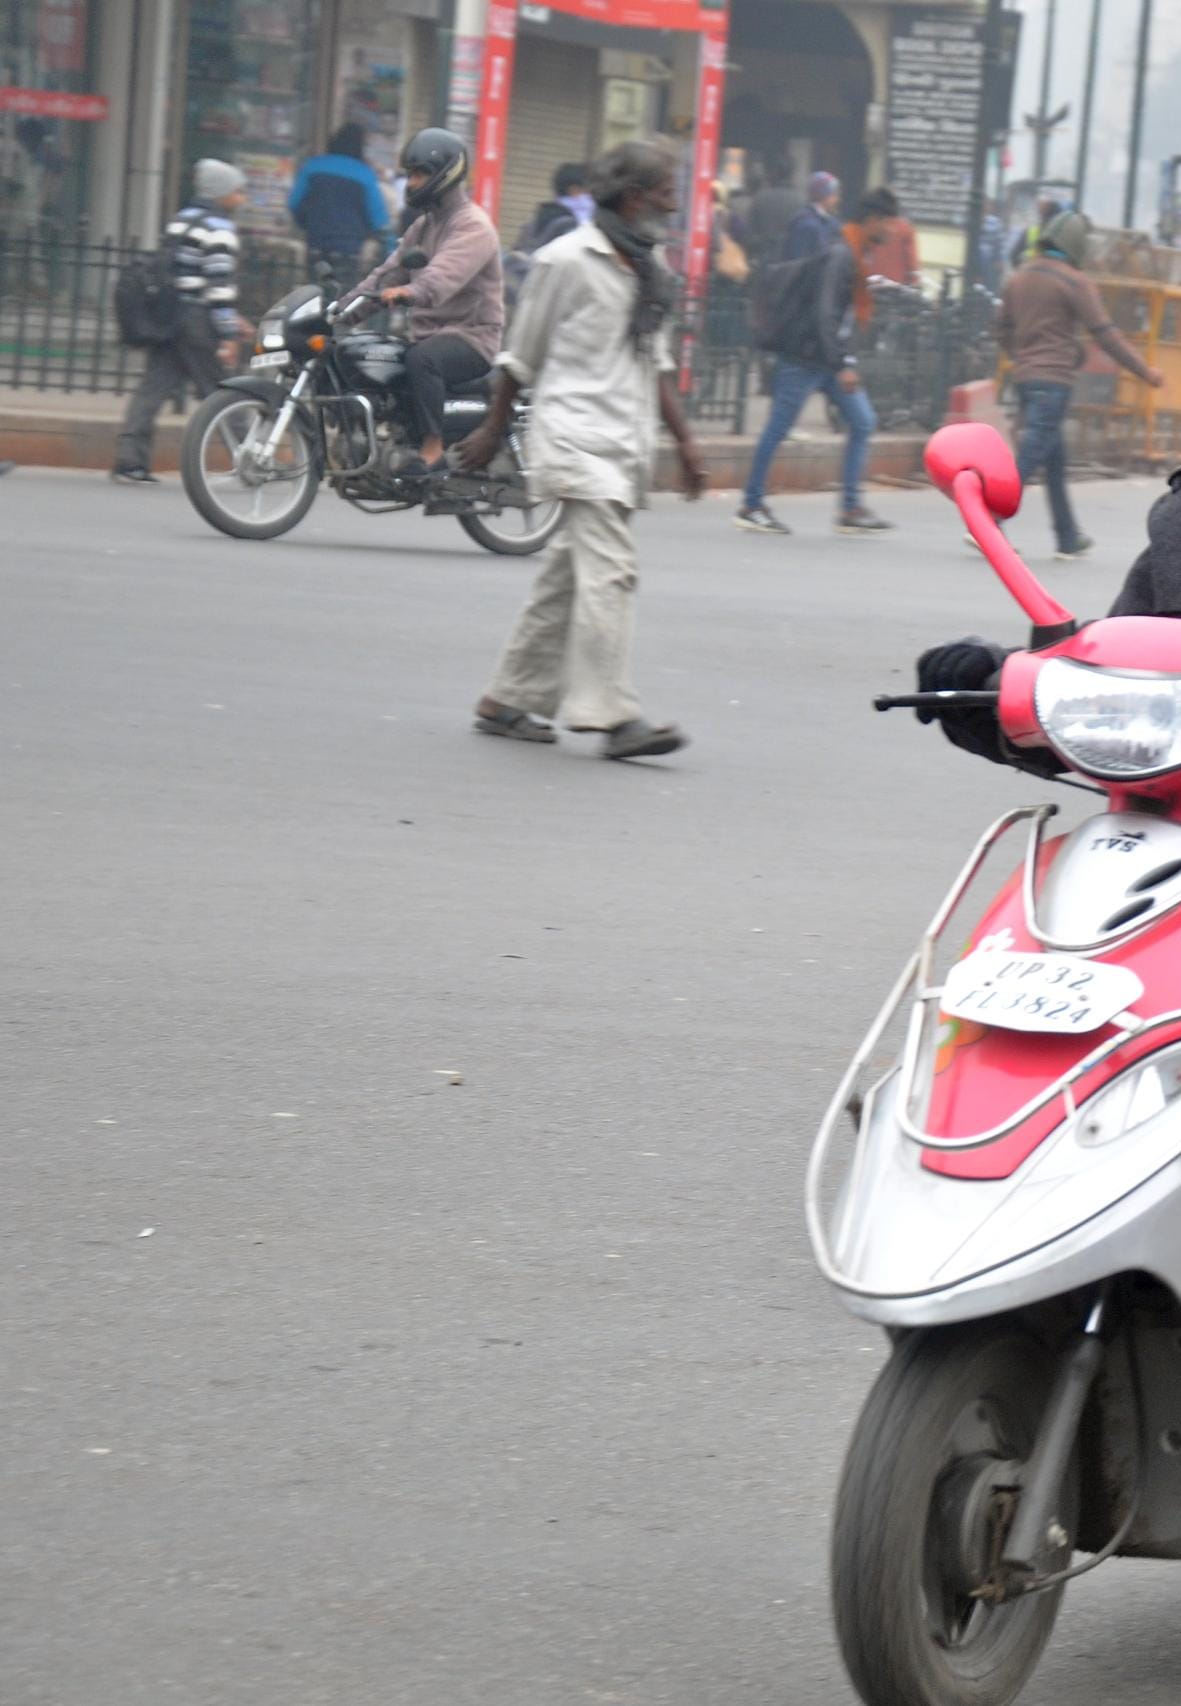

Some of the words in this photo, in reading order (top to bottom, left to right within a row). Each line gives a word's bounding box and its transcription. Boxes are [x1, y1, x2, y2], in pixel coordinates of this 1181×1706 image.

[1089, 838, 1138, 853] TVS
[995, 960, 1045, 979] UP
[1046, 966, 1096, 990] 32
[1003, 992, 1092, 1024] 3824
